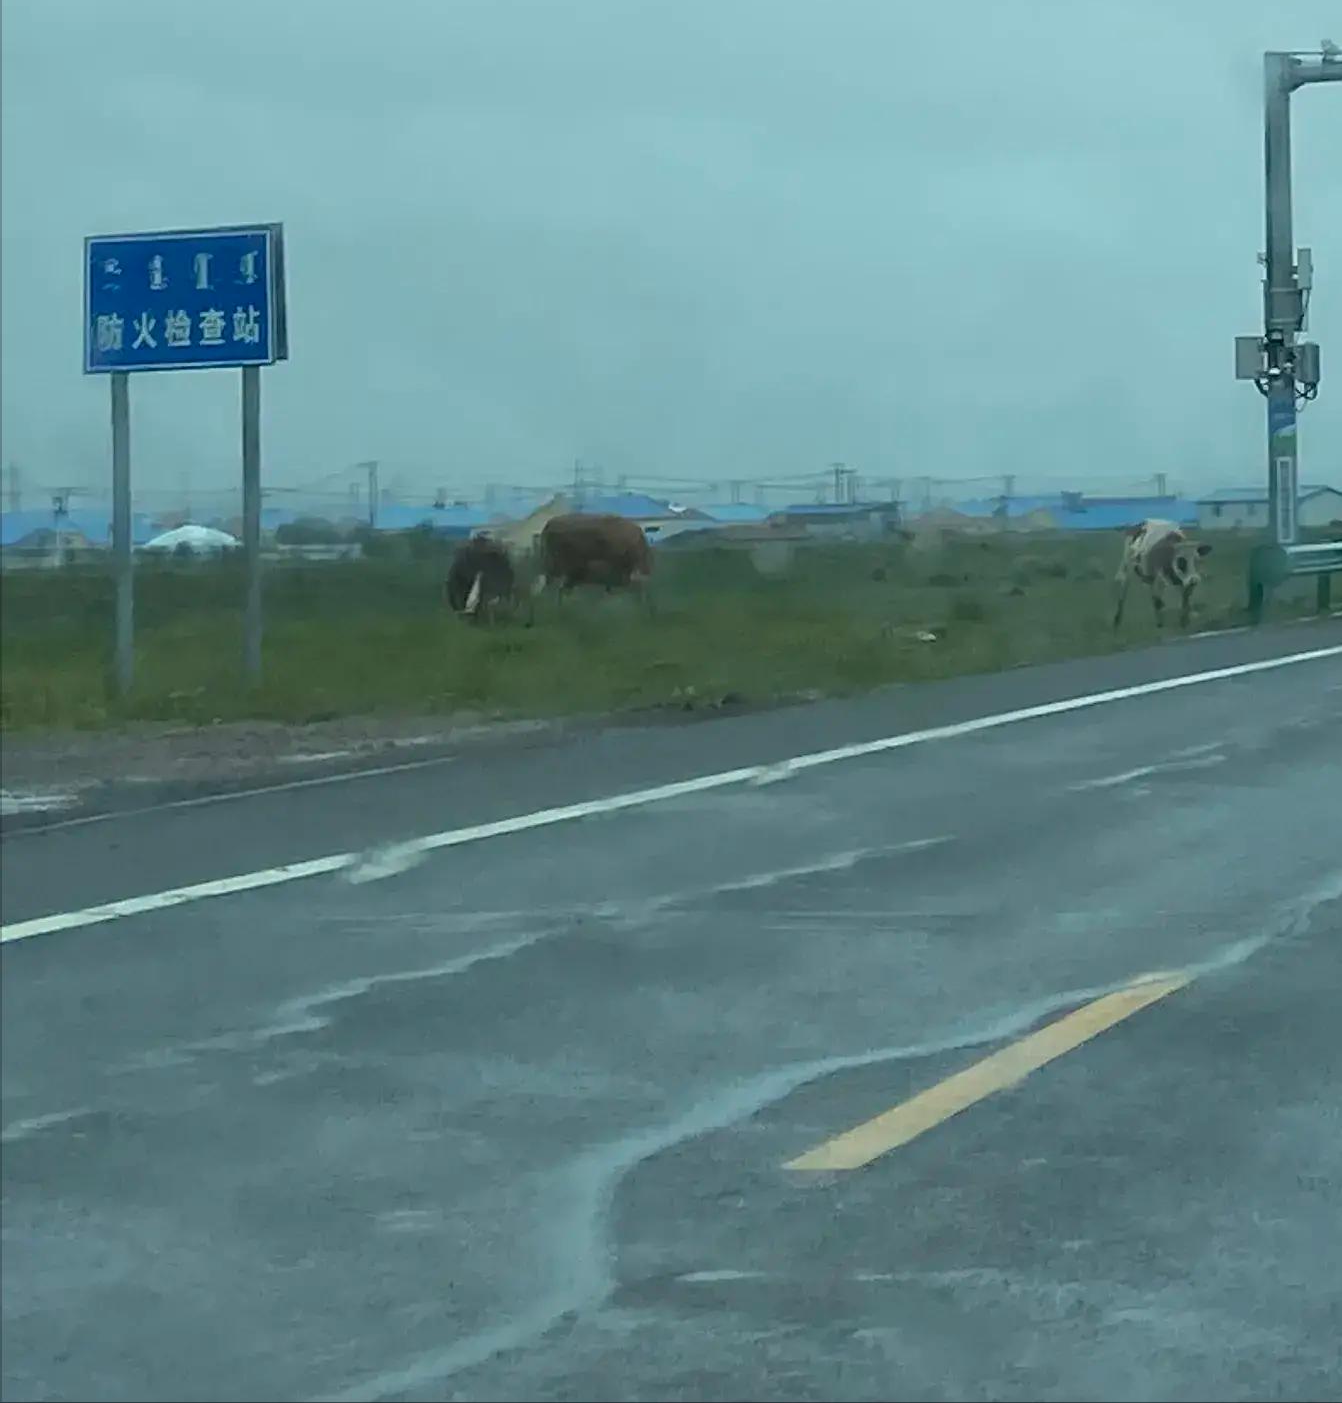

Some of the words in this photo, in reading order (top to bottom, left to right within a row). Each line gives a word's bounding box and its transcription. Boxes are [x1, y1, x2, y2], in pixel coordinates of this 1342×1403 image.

[95, 305, 260, 352] 防火检查站
